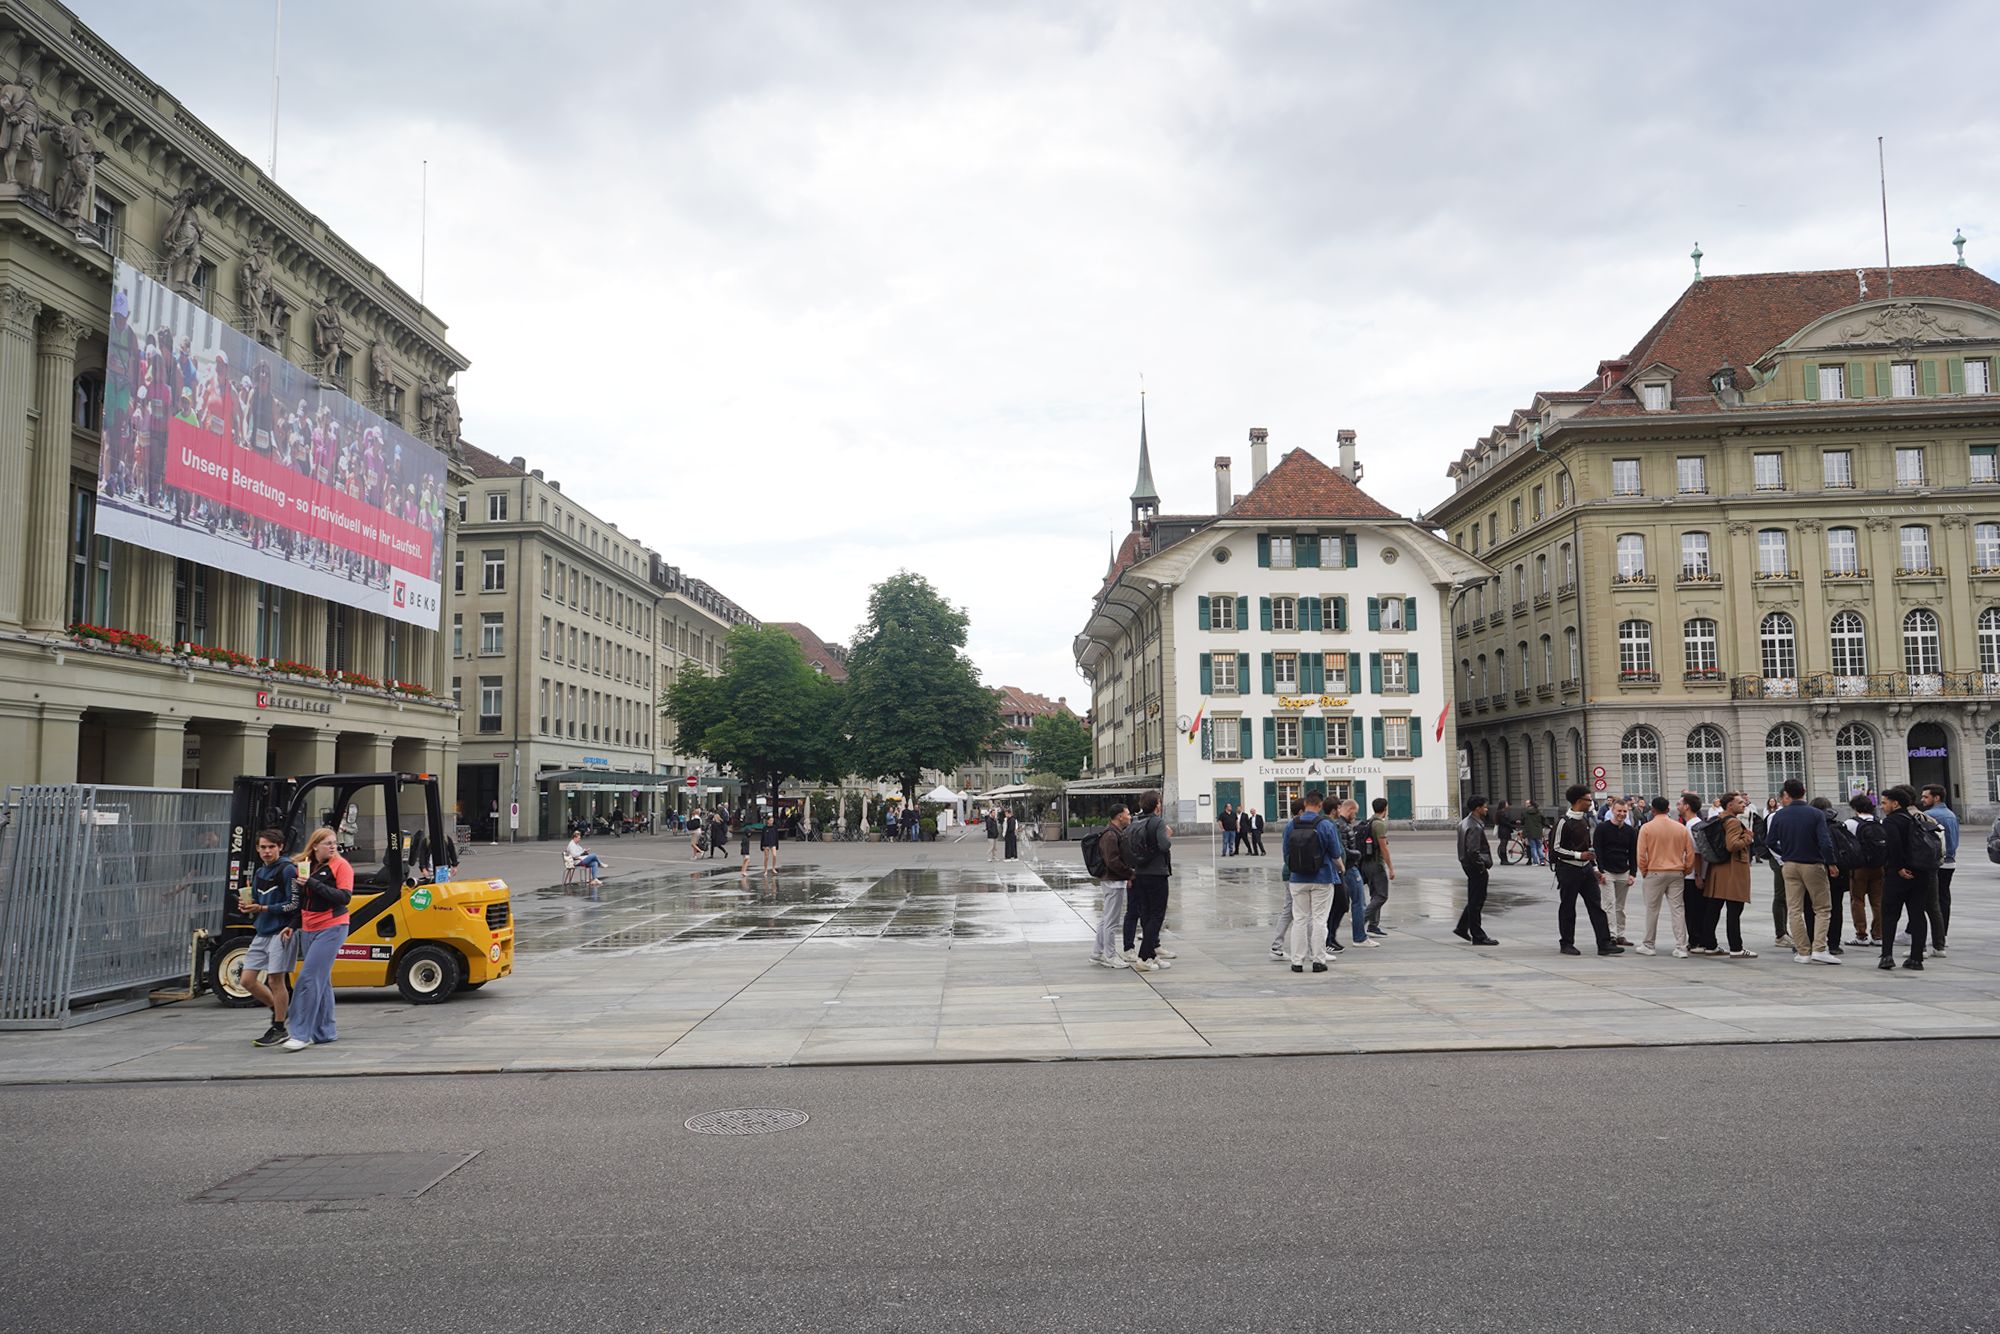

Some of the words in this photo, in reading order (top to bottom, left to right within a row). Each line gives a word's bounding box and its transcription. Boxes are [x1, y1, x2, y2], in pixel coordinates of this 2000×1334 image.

[181, 446, 229, 481] Unsere
[231, 467, 285, 508] Beratung
[296, 497, 309, 513] so
[311, 500, 361, 534] individuell
[362, 524, 377, 540] wie
[379, 528, 391, 545] Ihr
[392, 534, 423, 560] Laufstil.
[409, 591, 436, 612] BEKB
[231, 825, 244, 853] Yale
